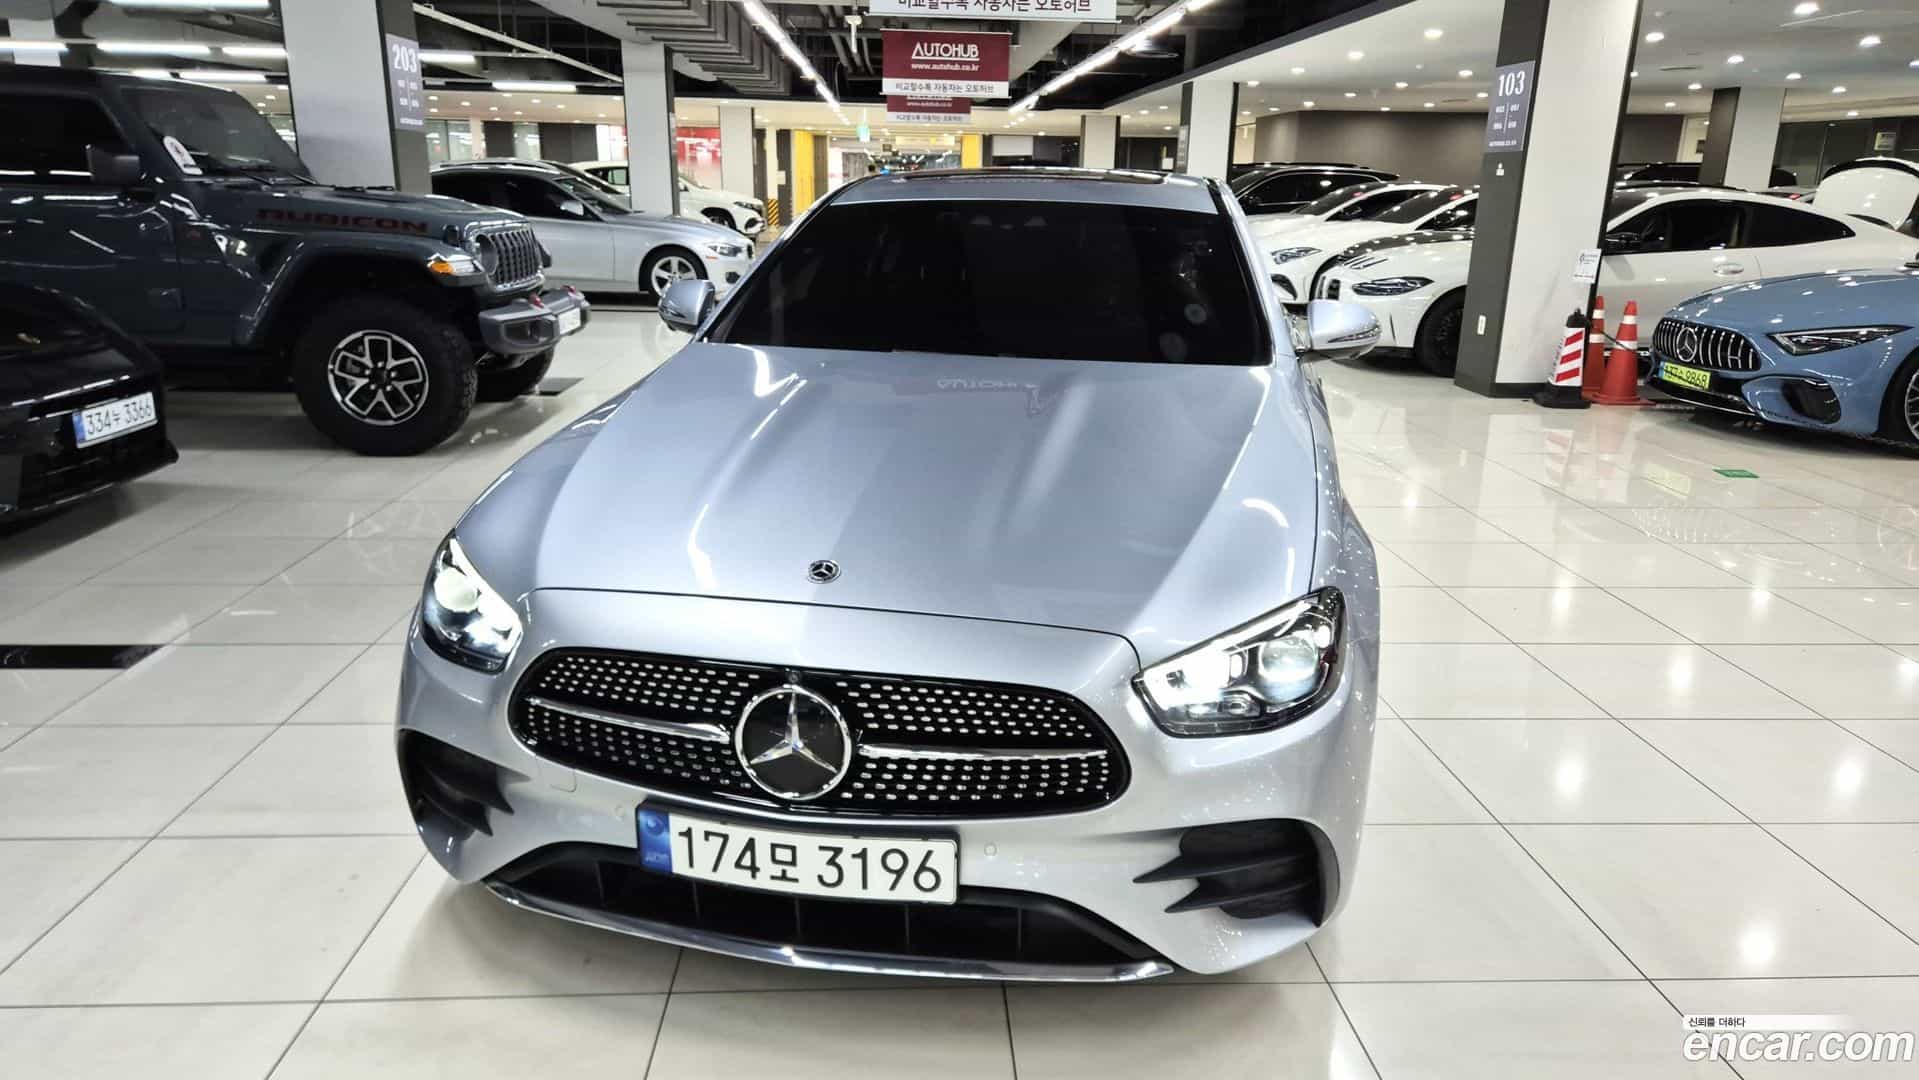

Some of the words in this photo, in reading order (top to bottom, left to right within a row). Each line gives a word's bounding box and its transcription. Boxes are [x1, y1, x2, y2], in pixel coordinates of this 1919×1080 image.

[392, 44, 417, 72] 203
[911, 41, 979, 60] AUTOHUB
[911, 63, 980, 71] www.autohub.co.kr
[1499, 71, 1525, 96] 103
[256, 208, 428, 233] RUBICON
[678, 827, 799, 883] 174모
[817, 845, 942, 893] 3196
